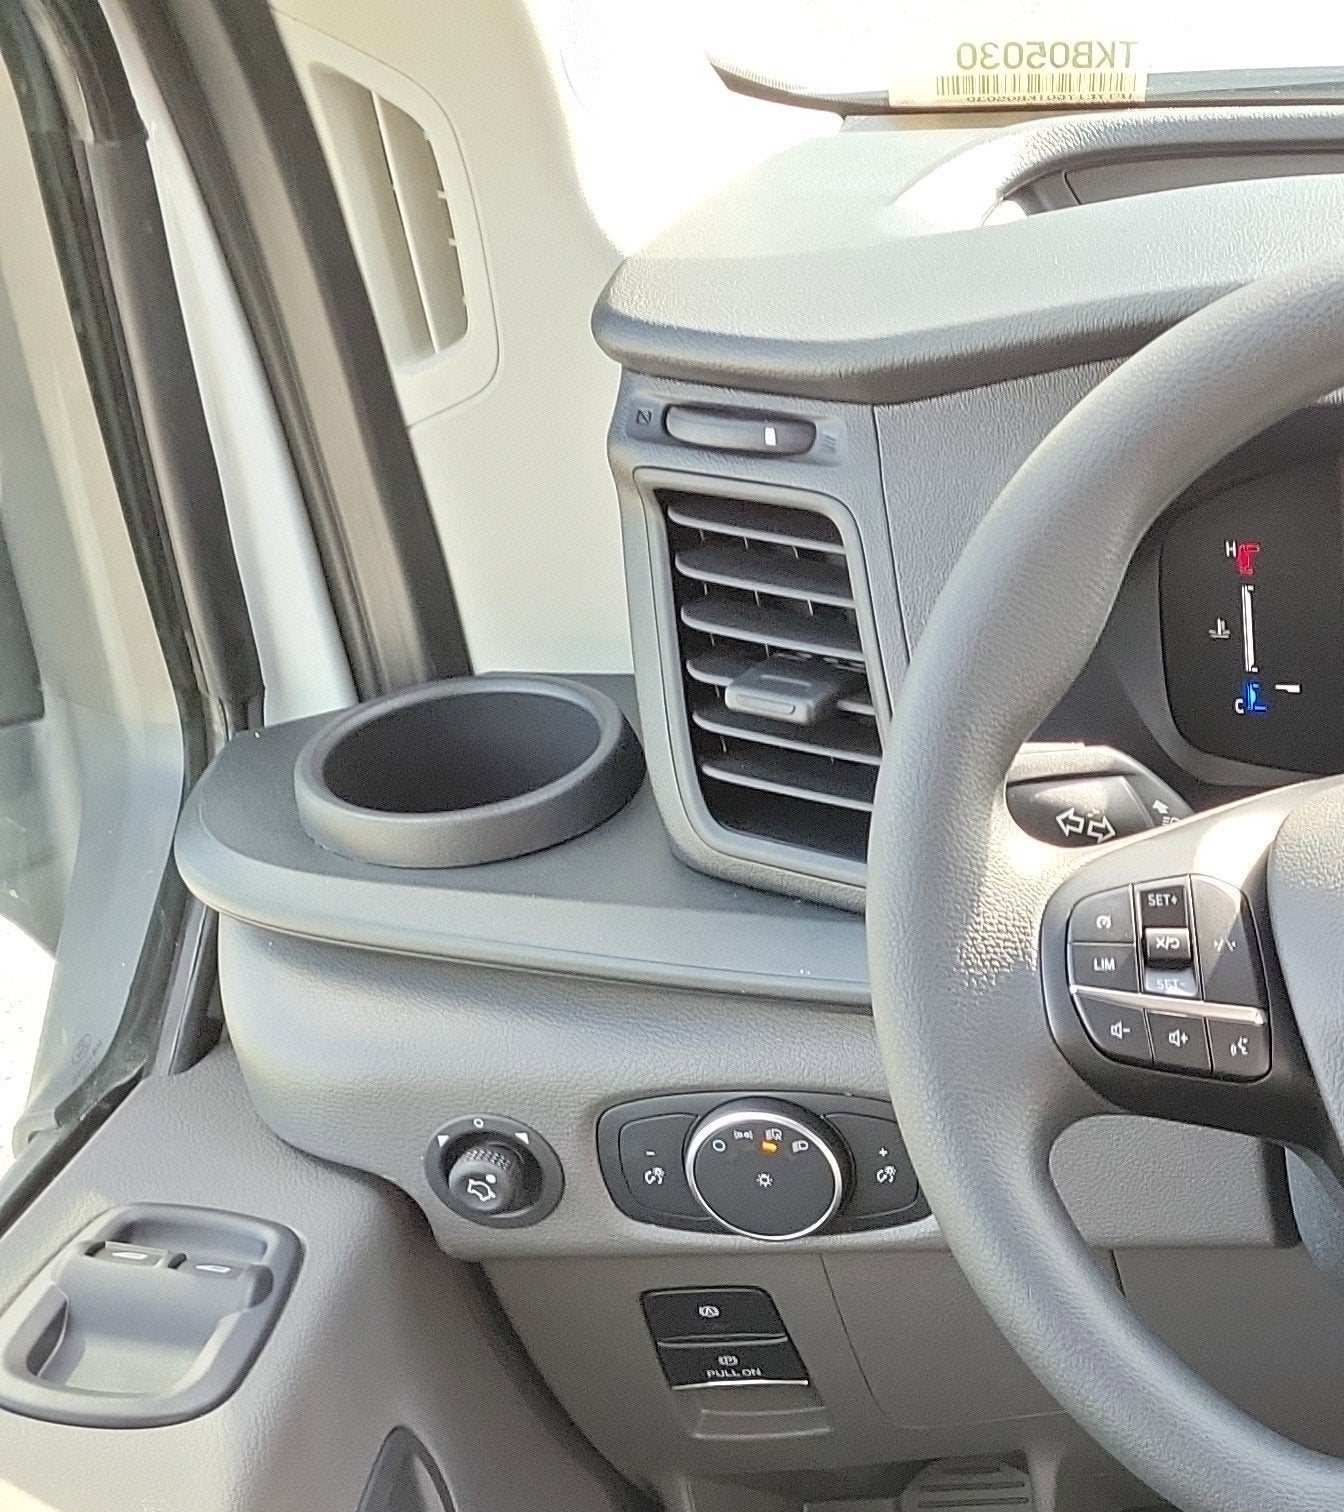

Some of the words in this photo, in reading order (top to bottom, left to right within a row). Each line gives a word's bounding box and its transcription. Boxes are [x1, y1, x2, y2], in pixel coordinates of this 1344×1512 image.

[1225, 540, 1237, 557] H
[1093, 957, 1116, 972] LIM
[706, 1368, 740, 1378] PULL
[742, 1367, 762, 1377] ON
